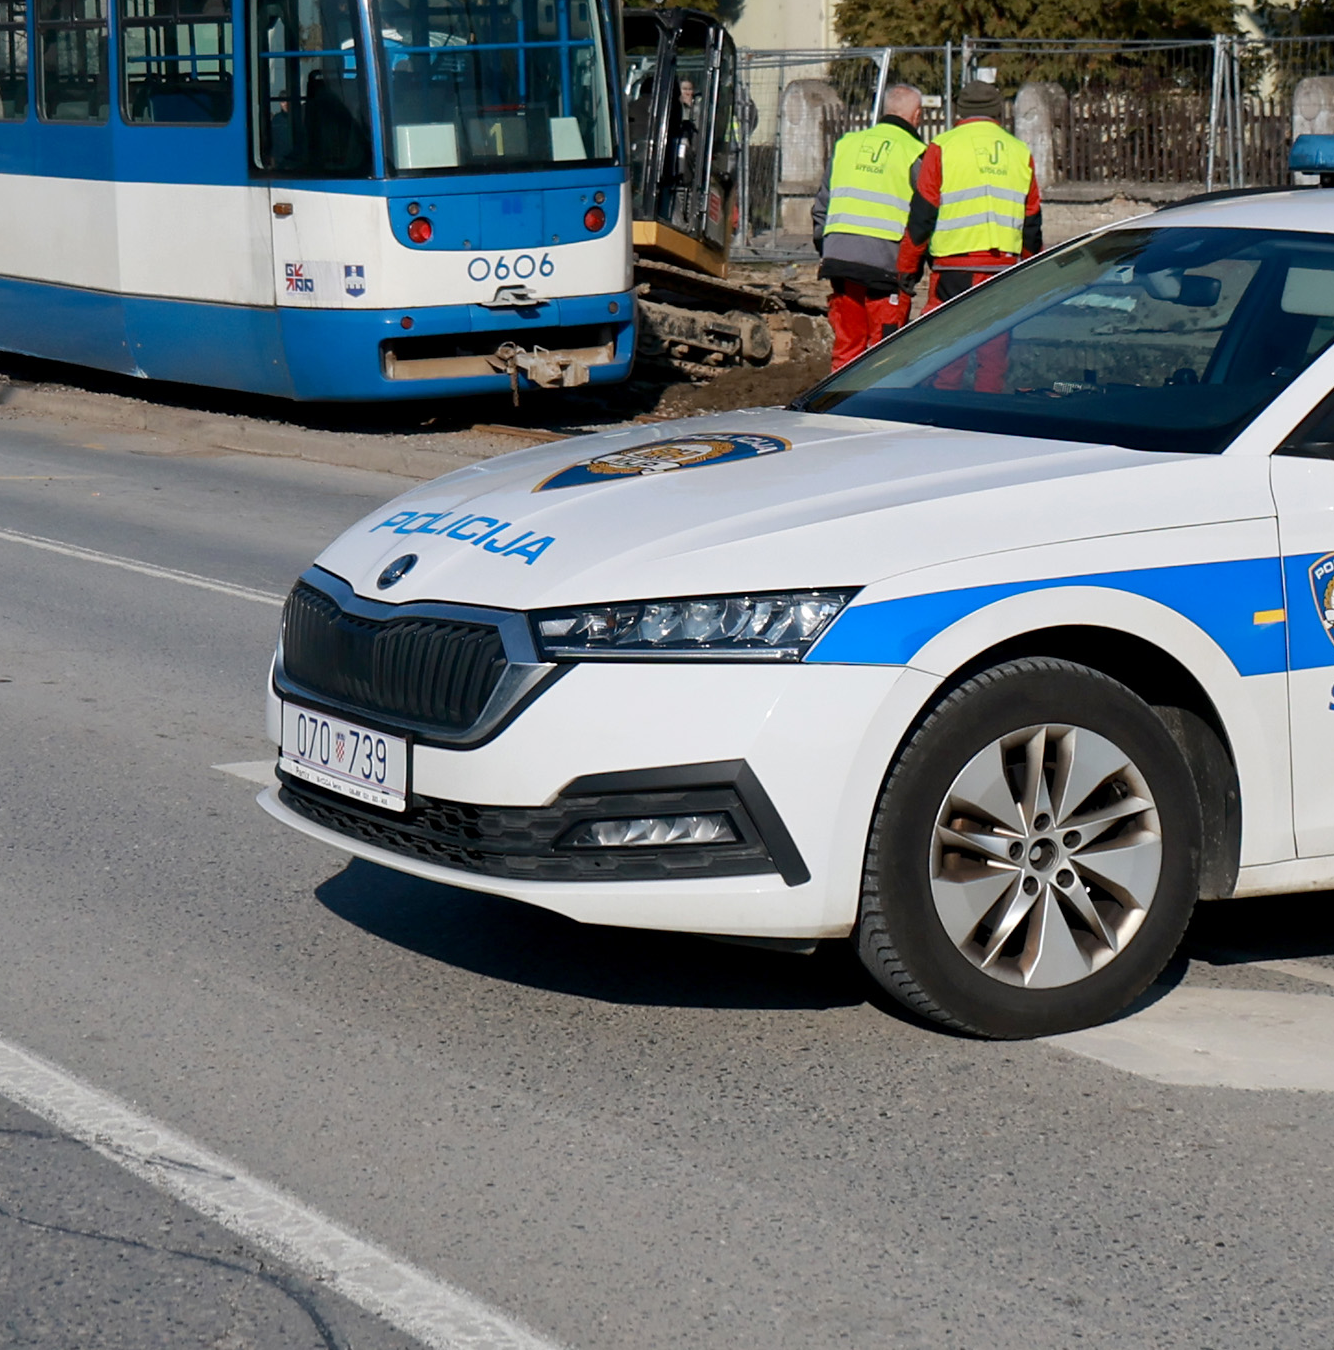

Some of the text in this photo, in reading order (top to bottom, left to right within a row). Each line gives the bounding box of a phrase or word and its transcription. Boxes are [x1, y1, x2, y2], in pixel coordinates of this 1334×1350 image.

[489, 122, 505, 156] 1
[467, 252, 555, 282] 0606
[368, 511, 556, 566] POLICIJA
[297, 713, 387, 784] 070 739
